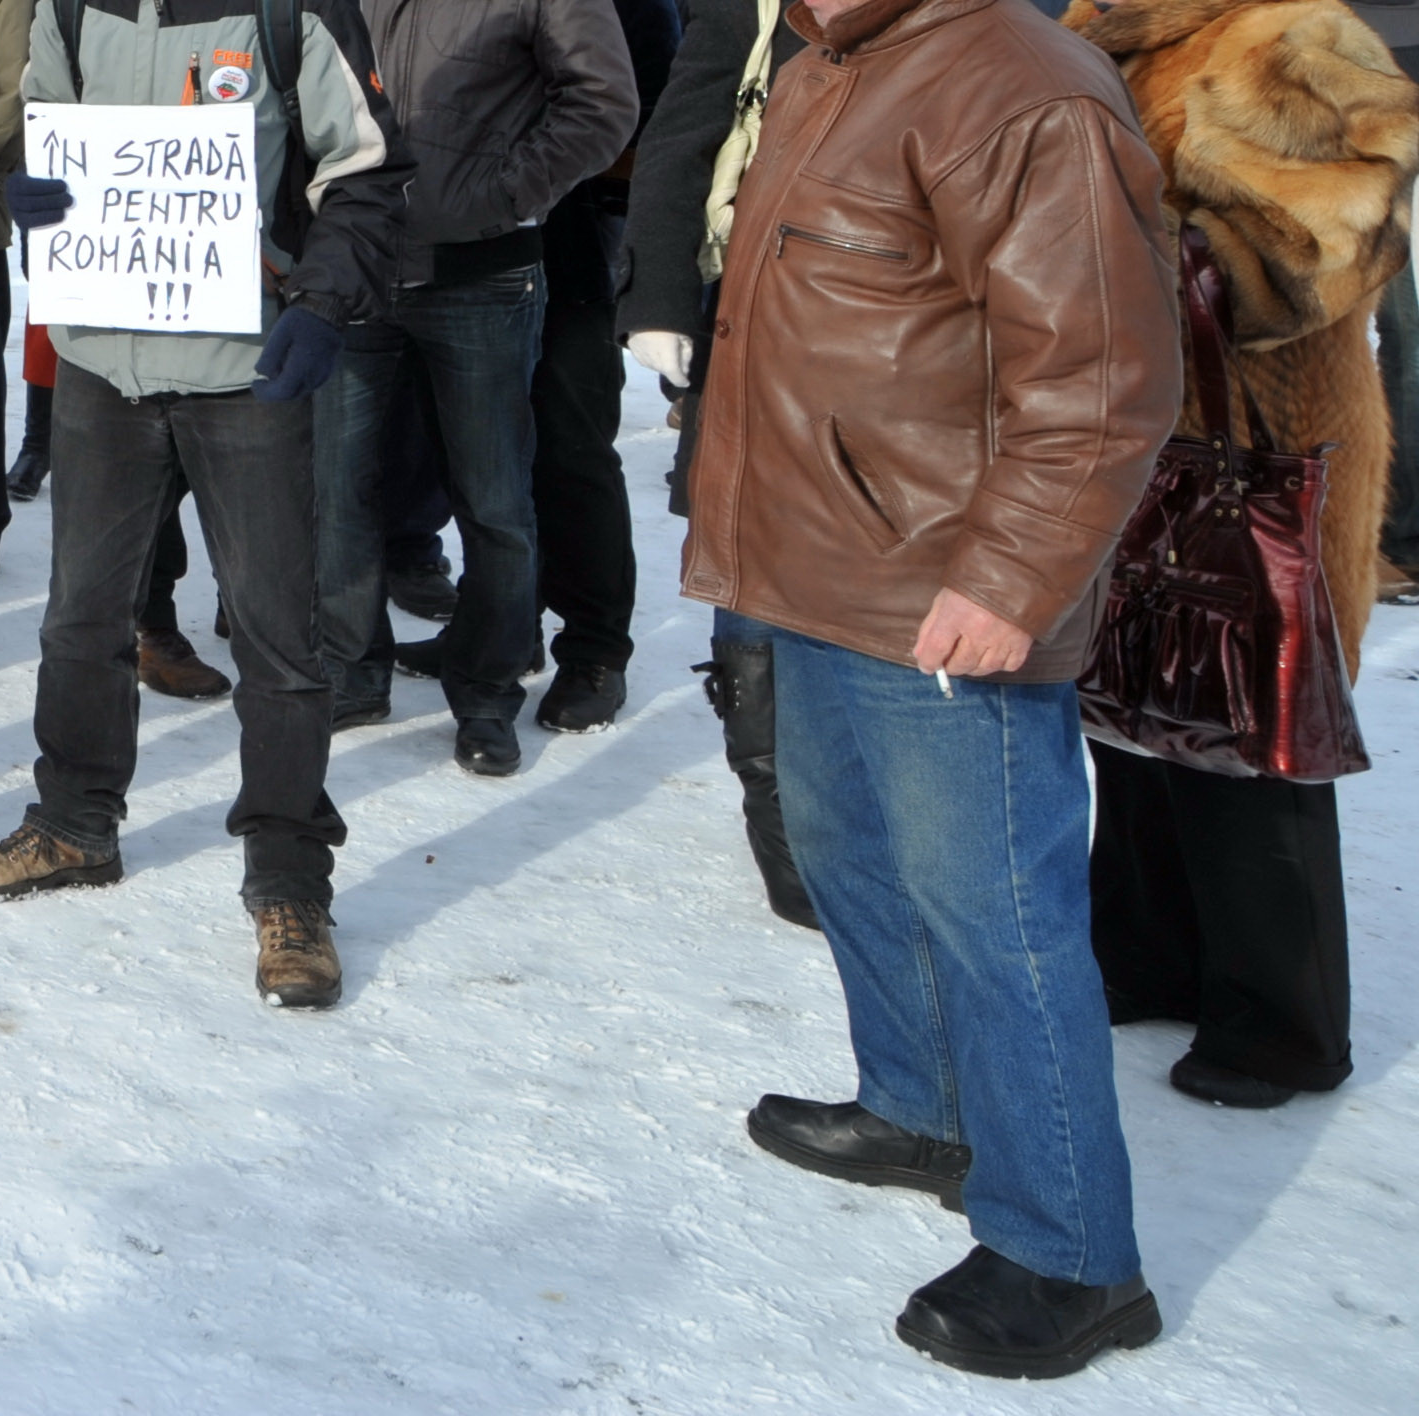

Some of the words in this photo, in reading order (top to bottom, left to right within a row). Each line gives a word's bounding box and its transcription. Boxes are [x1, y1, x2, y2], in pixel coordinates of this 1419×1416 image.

[43, 129, 88, 178] ÎN
[101, 187, 242, 226] PENTRU
[146, 281, 193, 322] !!!
